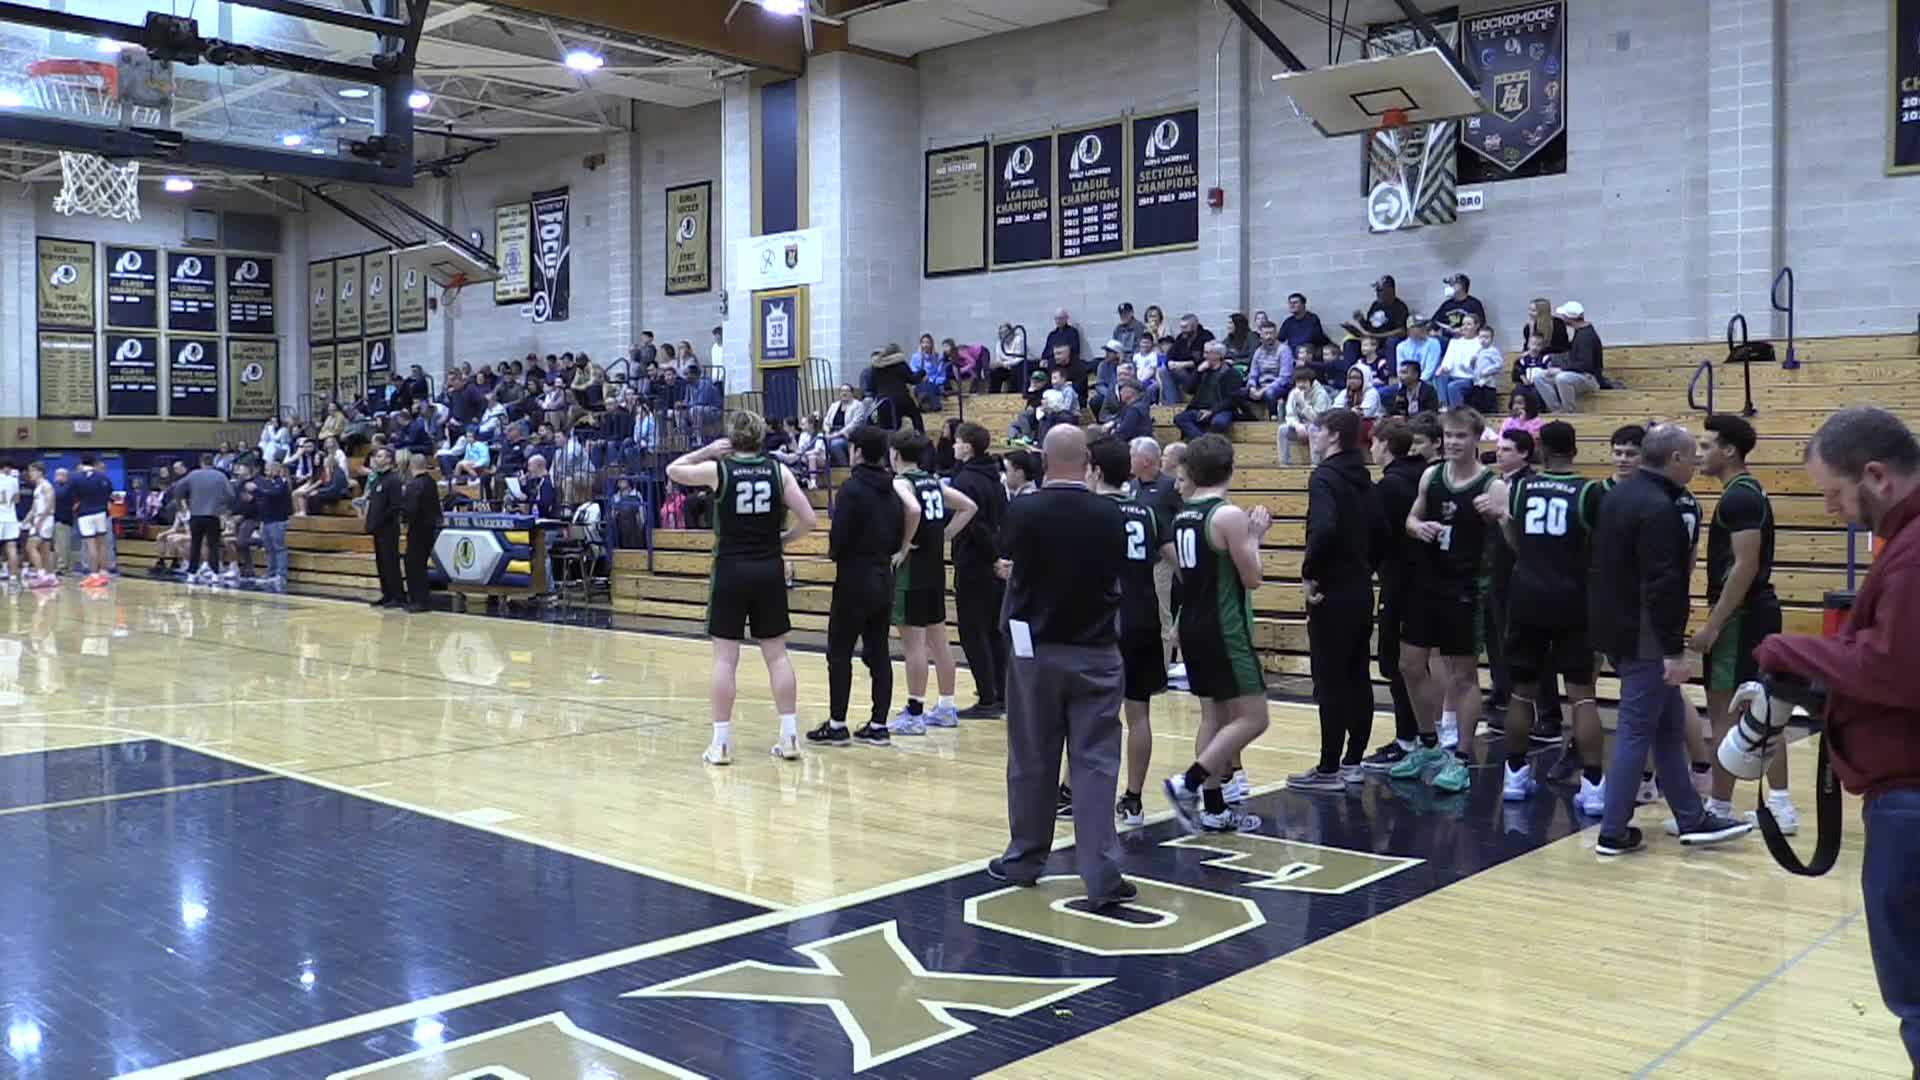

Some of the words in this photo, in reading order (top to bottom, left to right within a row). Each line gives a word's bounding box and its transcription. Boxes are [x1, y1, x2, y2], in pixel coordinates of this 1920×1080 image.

[1471, 6, 1555, 32] HOCKOMOCK
[1140, 164, 1195, 182] SECTIONAL
[1072, 178, 1109, 193] LEAGUE
[1136, 175, 1199, 194] CHAMPIONS
[1006, 188, 1039, 202] LEAGUE
[1060, 187, 1120, 206] CHAMPIONS
[996, 198, 1048, 214] CHAMPIONS
[538, 211, 564, 279] FOCUS
[678, 263, 696, 273] STATE
[670, 273, 706, 286] CHAMPIONS
[1526, 481, 1577, 495] MANSFIELD
[735, 480, 772, 515] 22
[921, 489, 944, 521] 33
[471, 518, 515, 529] WARRIORS
[1525, 496, 1569, 537] 20
[1175, 527, 1197, 569] 10
